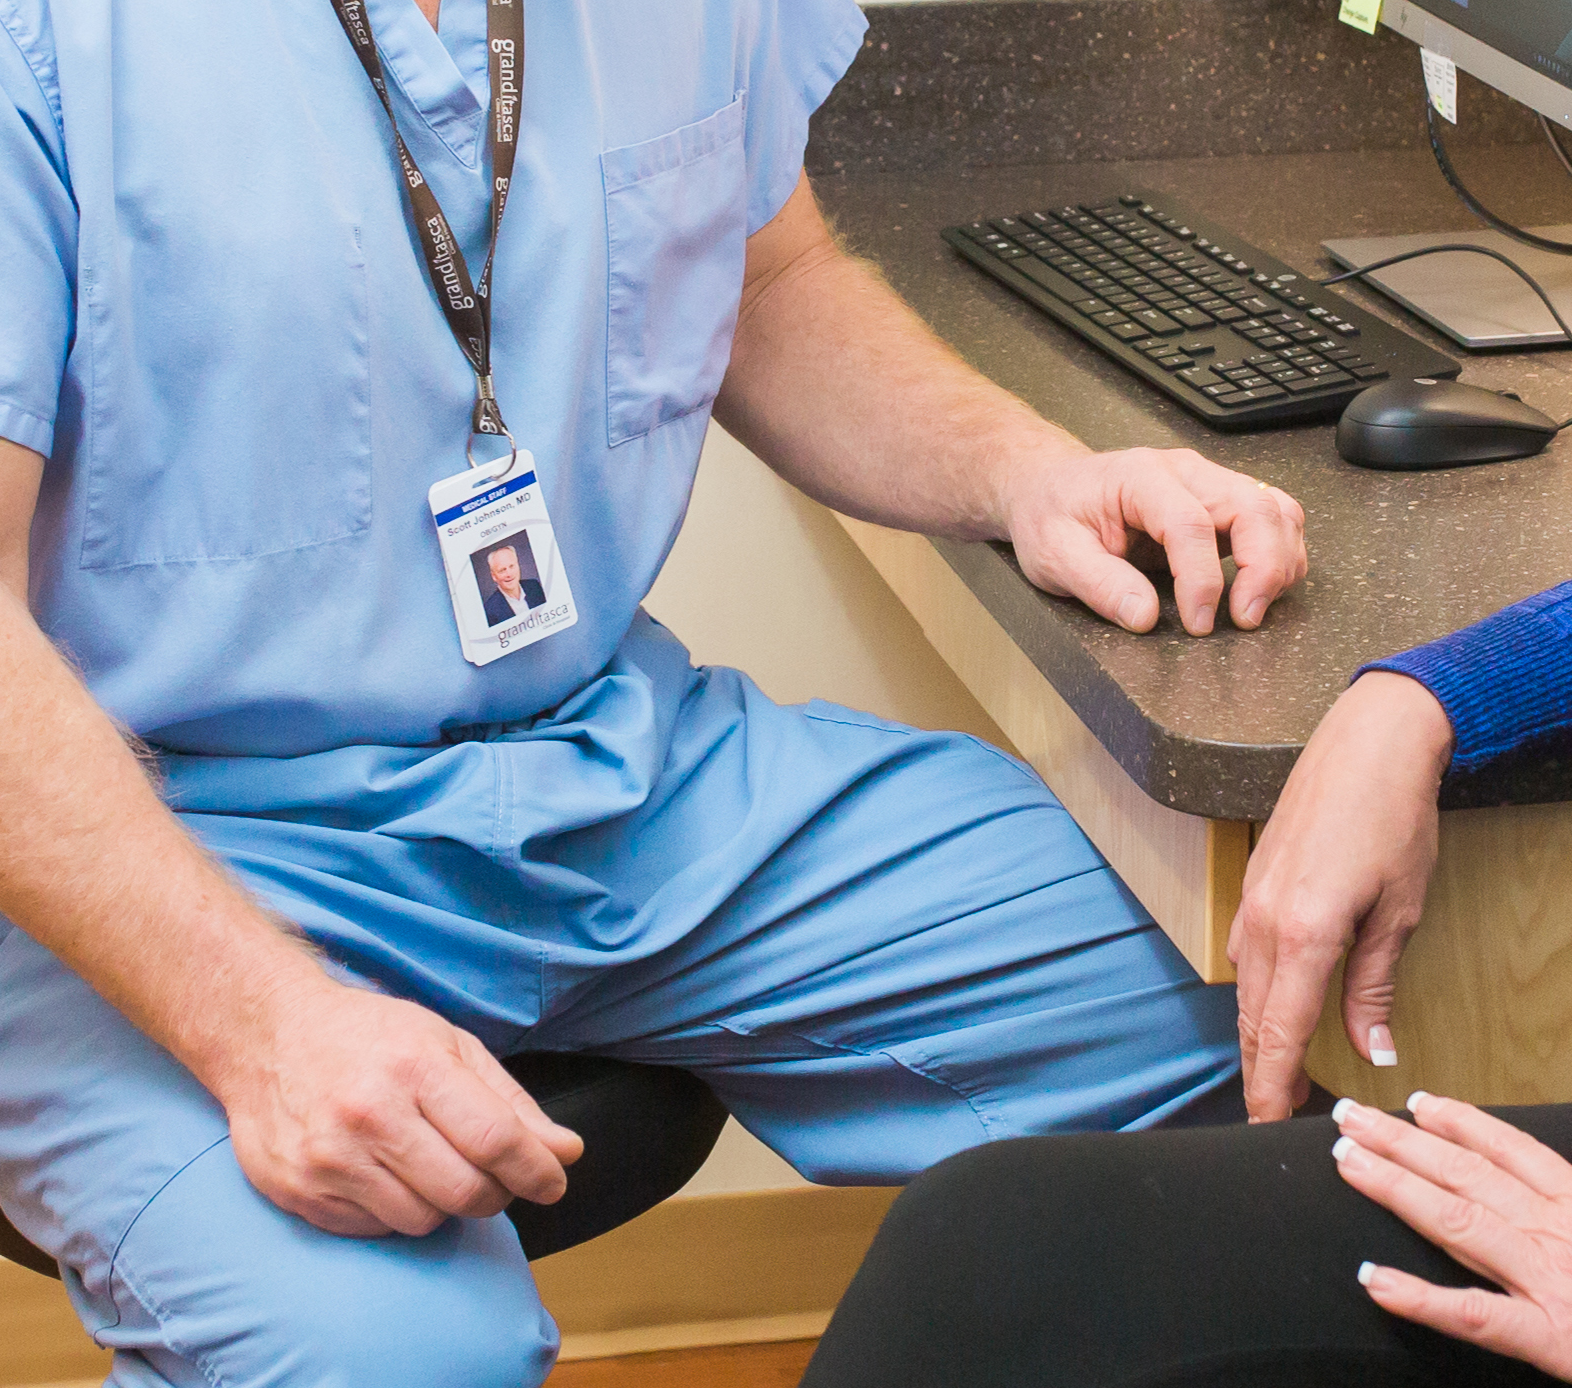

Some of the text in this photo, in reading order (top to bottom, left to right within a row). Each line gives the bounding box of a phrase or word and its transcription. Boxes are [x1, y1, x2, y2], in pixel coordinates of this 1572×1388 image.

[447, 491, 531, 537] Scott Johnson, MD
[461, 486, 507, 513] MEDICAL STAFF
